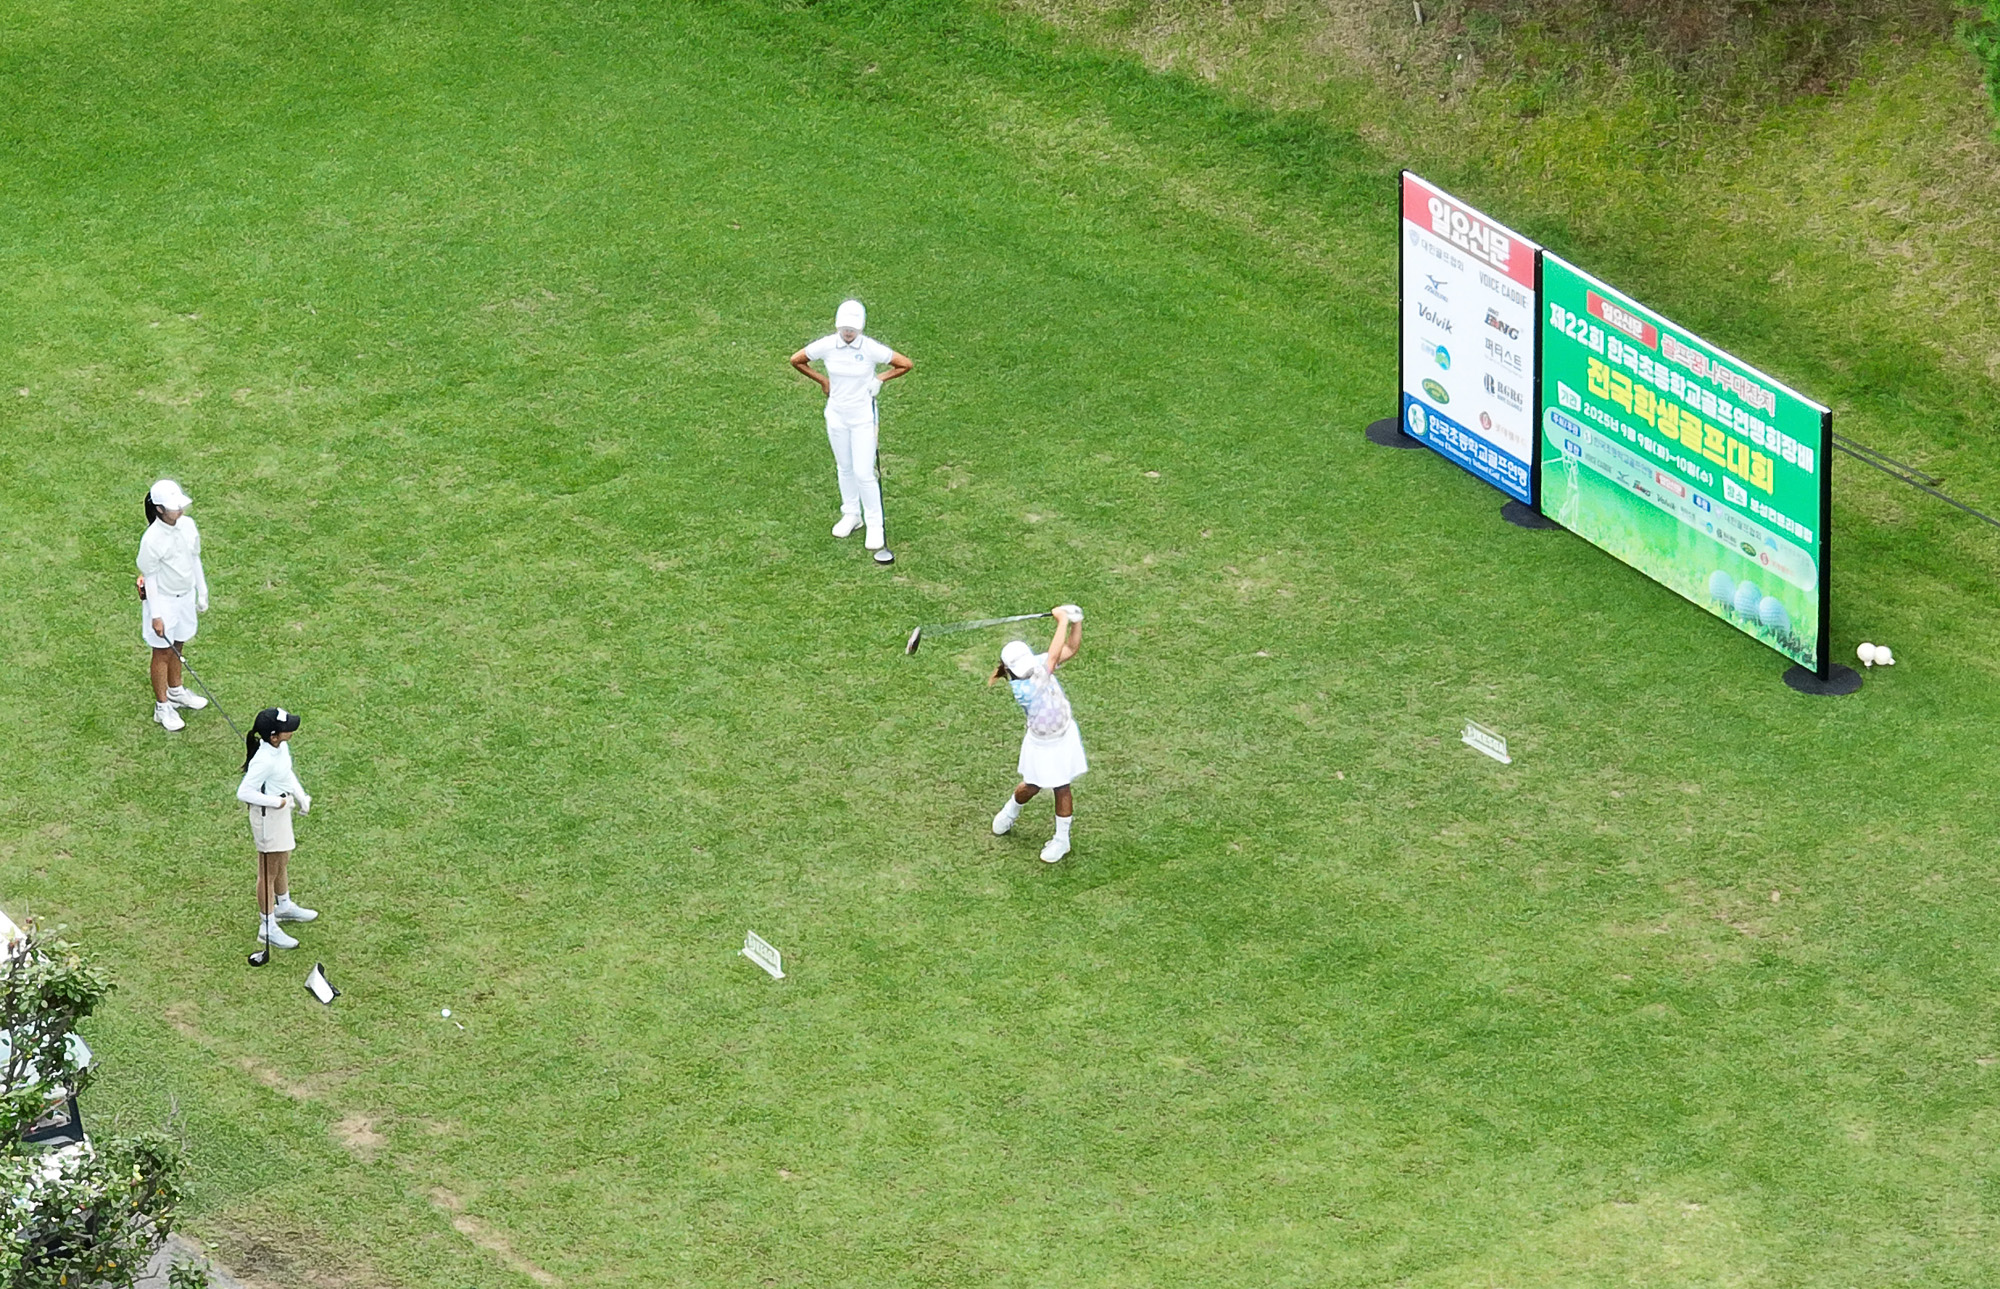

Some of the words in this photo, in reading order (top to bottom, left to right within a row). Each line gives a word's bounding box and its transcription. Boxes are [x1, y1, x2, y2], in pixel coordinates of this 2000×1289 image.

[1428, 197, 1510, 272] 일요신문
[1479, 271, 1500, 294] VOICE
[1501, 284, 1527, 309] CADDIE
[1417, 301, 1453, 335] Volvik
[1601, 300, 1642, 339] 일요신문
[1485, 337, 1522, 372] 퍼티스트
[1661, 332, 1775, 417] 골프꿈나무대잔치
[1550, 301, 1604, 355] 제22회
[1607, 334, 1813, 474] 한국초등학교골프연맹회장배
[1584, 401, 1618, 432] 2025년
[1620, 422, 1635, 442] 9월
[1587, 355, 1773, 495] 전국학생골프대회
[1429, 414, 1528, 487] 한국초등학교골프연맹
[1727, 484, 1744, 503] 장소
